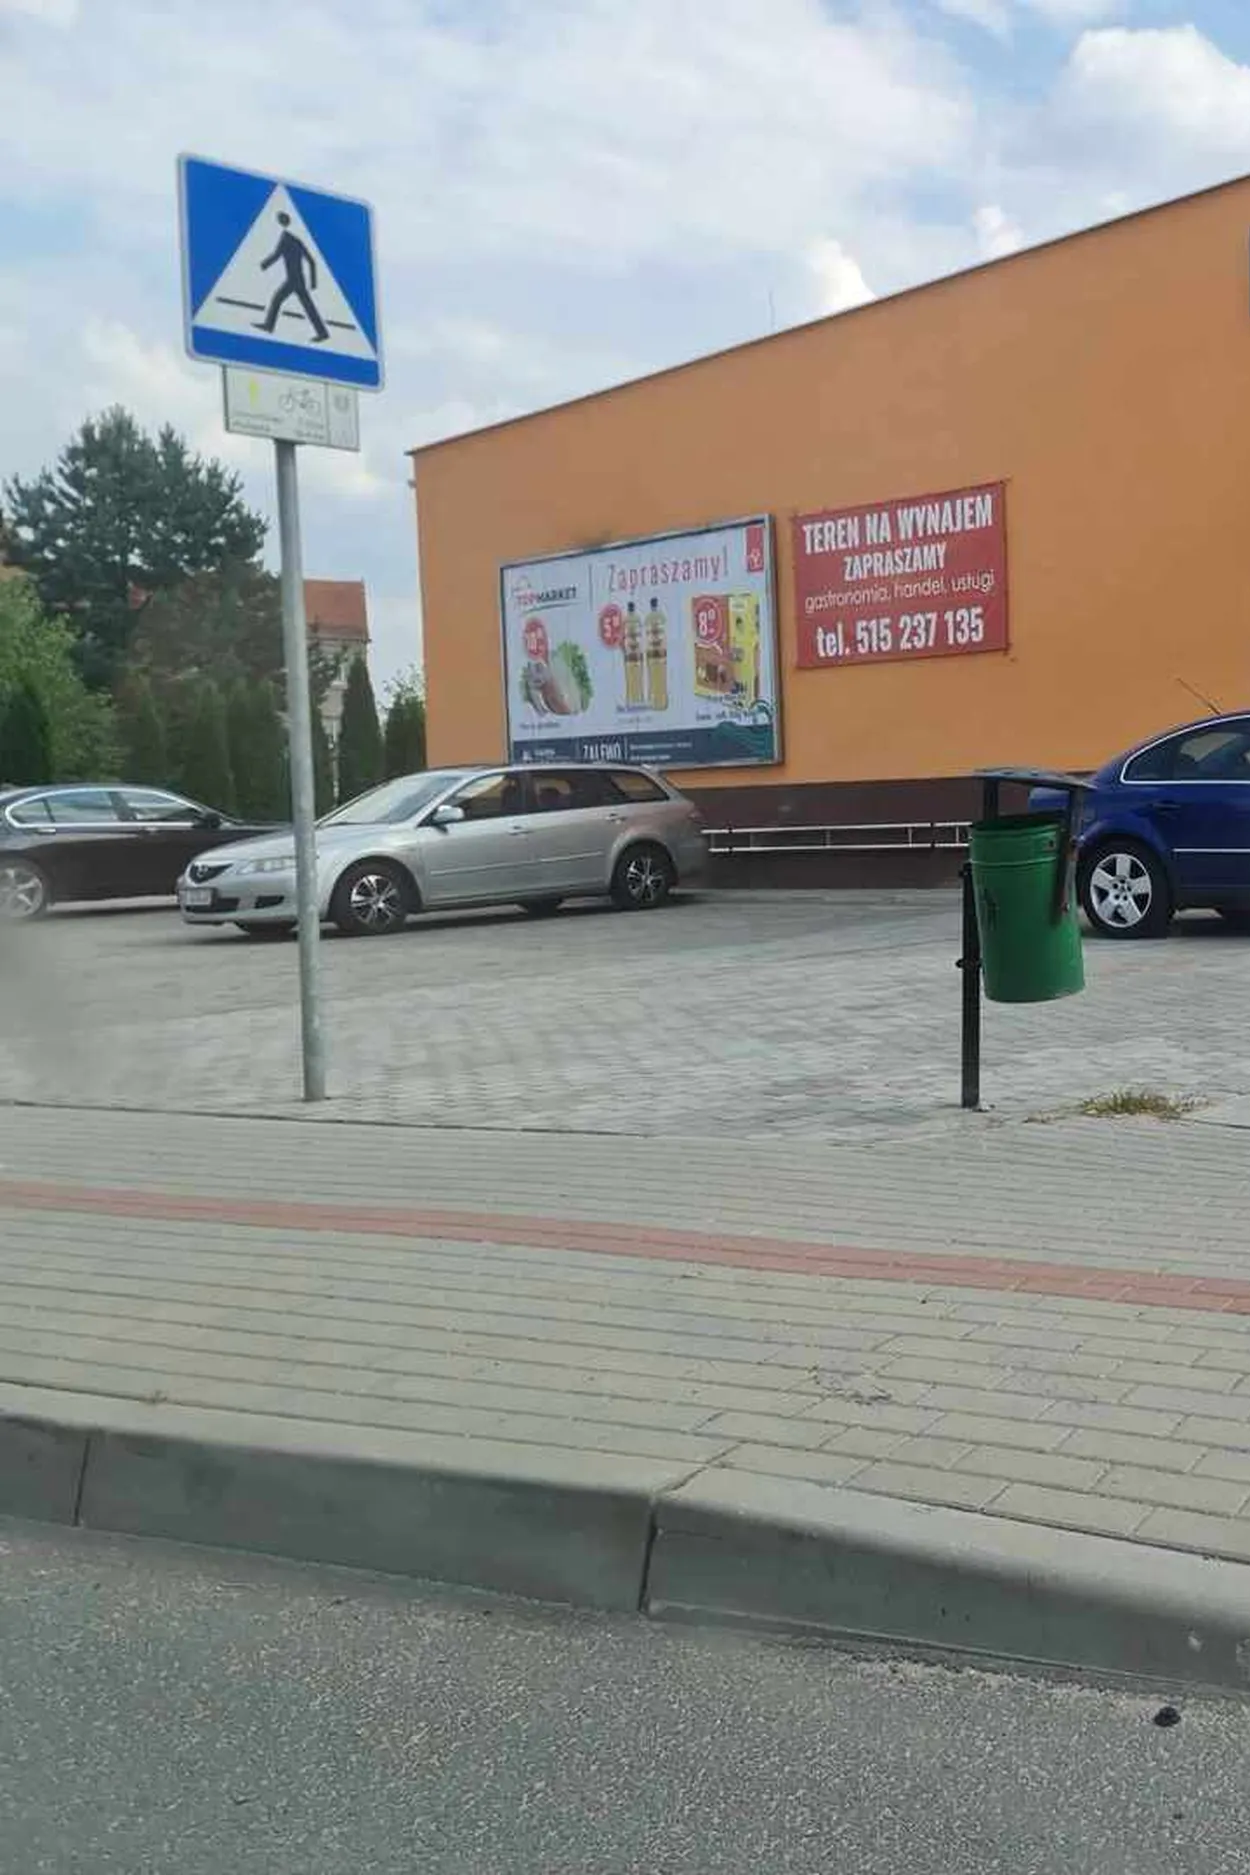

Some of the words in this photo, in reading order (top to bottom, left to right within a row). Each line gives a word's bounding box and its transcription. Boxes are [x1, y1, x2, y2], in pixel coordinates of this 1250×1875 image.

[803, 516, 859, 555] TEREN
[866, 511, 891, 544] NA
[897, 493, 993, 540] WYNAJEM
[607, 546, 729, 594] Zapraszamy!
[843, 541, 947, 582] ZAPRASZAMY
[805, 584, 891, 613] gastronomia,
[816, 621, 850, 658] tel.
[855, 618, 892, 653] 515
[898, 612, 937, 650] 237
[943, 606, 984, 645] 135
